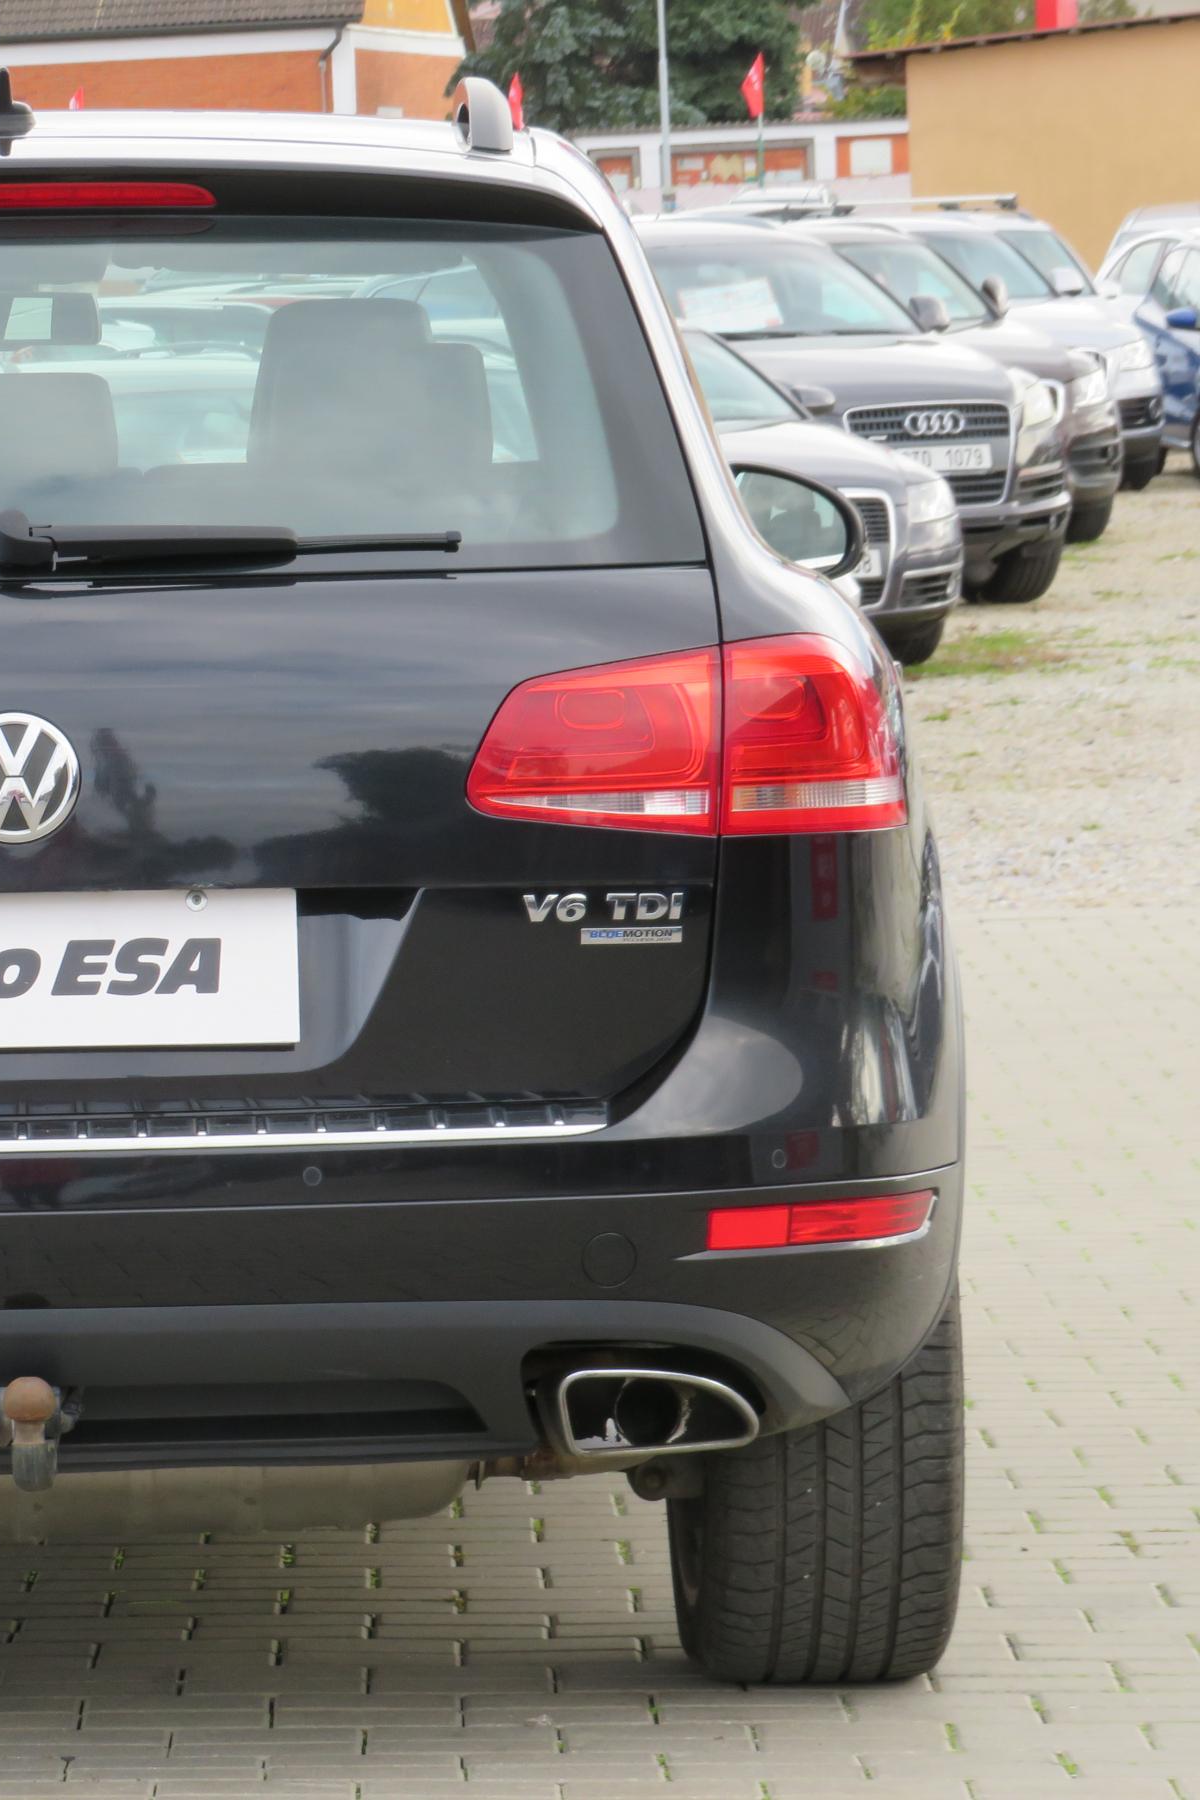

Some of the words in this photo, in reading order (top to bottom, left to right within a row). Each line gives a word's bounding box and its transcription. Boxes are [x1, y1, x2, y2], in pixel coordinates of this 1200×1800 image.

[522, 893, 587, 922] V6
[606, 892, 684, 920] TDI
[51, 938, 222, 996] ESA
